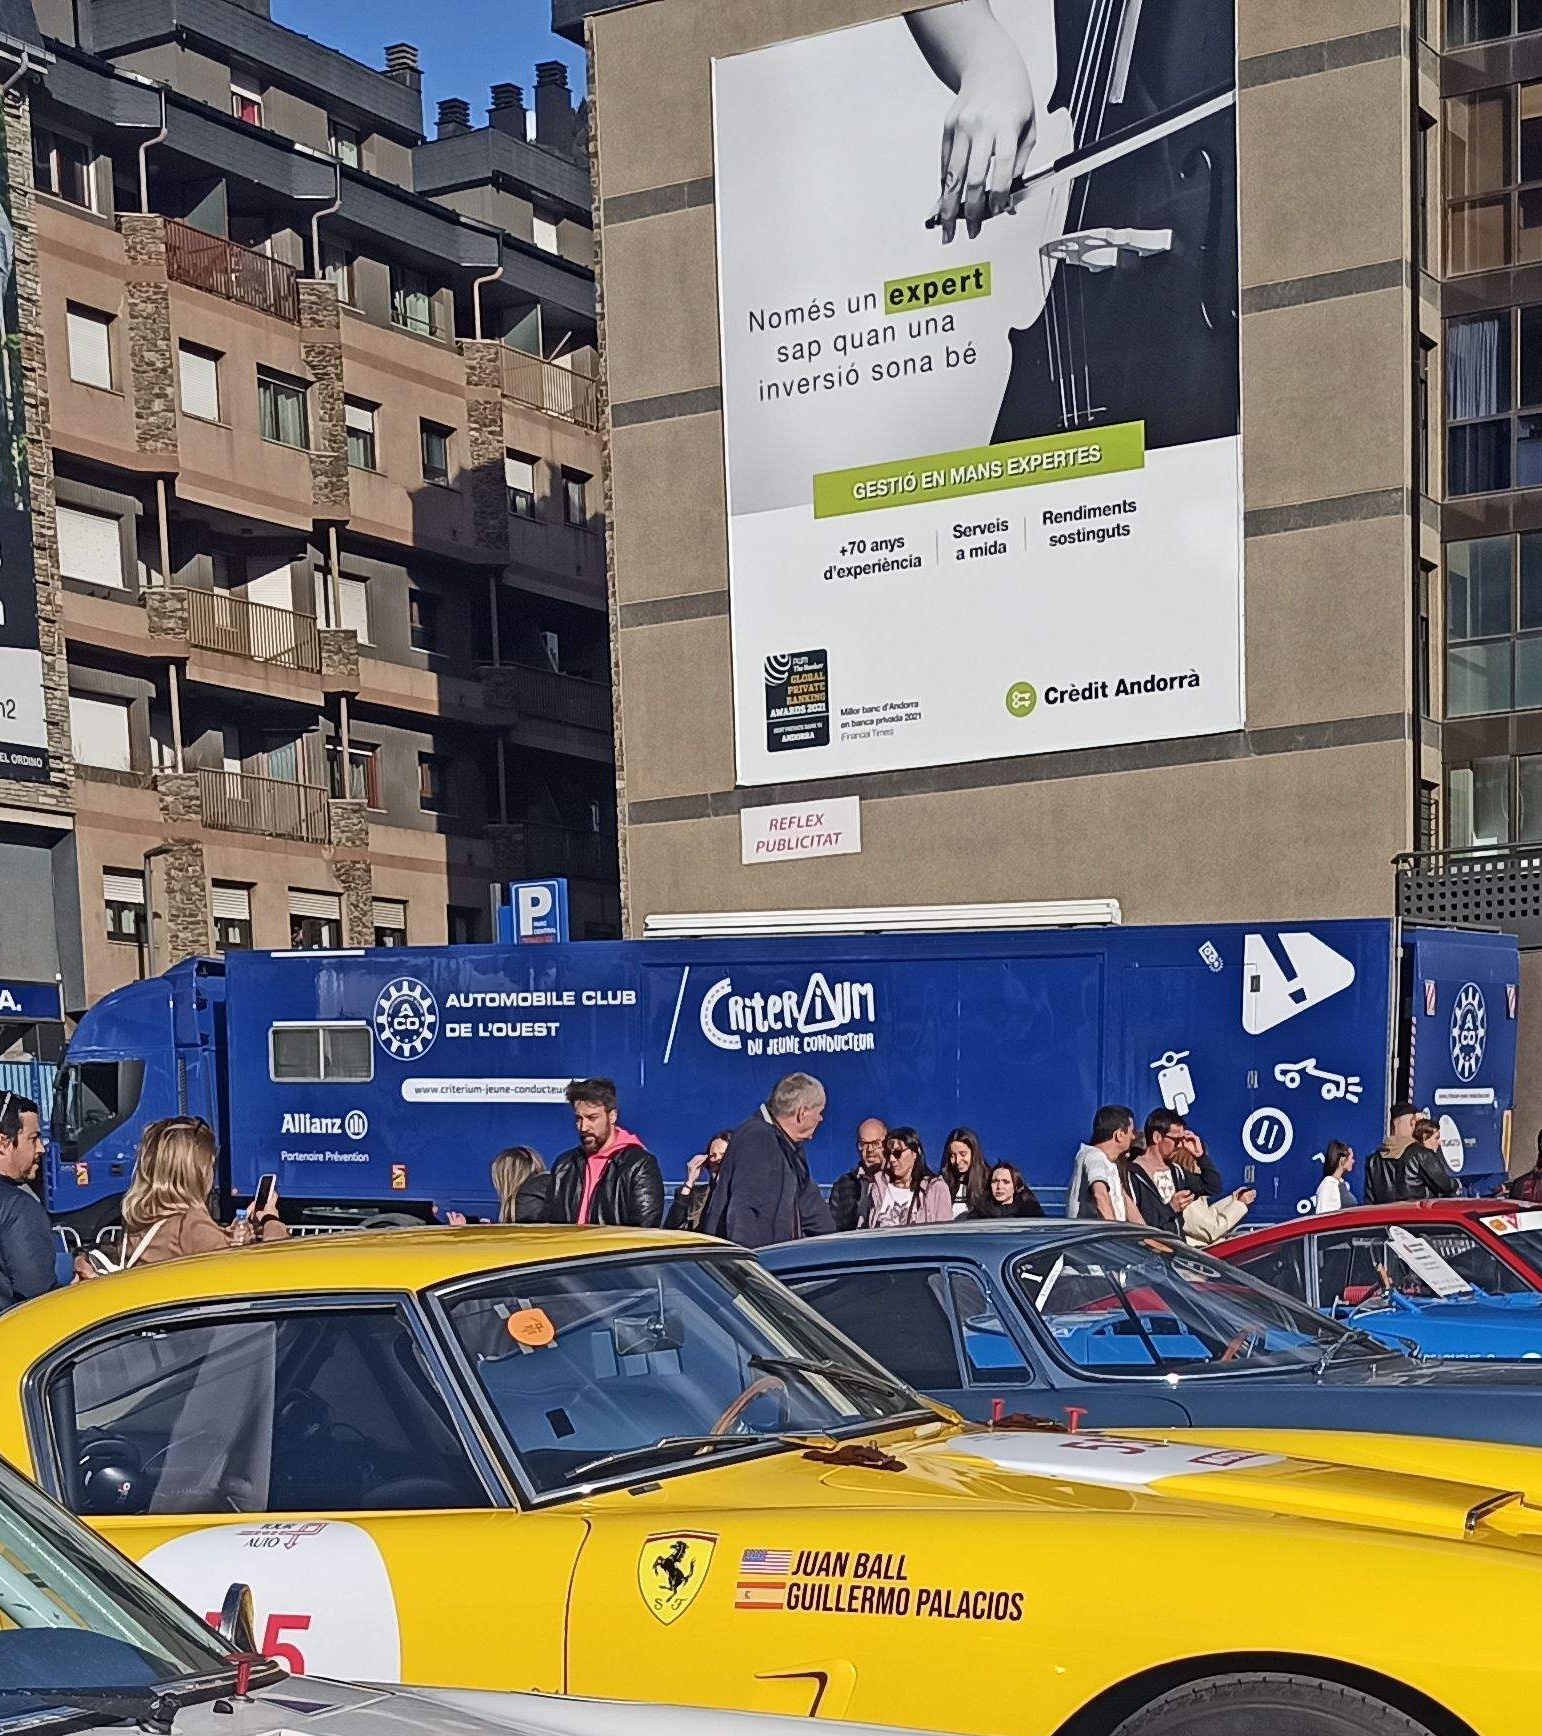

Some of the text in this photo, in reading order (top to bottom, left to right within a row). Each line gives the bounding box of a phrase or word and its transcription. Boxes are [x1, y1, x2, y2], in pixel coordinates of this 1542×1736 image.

[748, 267, 984, 333] Només un expert
[776, 313, 956, 364] sap quan una
[759, 340, 978, 402] inversió sona bé
[852, 443, 1103, 501] GESTIÓ EN MANS EXPERTES
[1042, 499, 1138, 527] Rendiments
[952, 518, 1010, 541] Serveis
[1048, 521, 1132, 549] sostinguts
[839, 535, 906, 559] +70 anys
[955, 541, 1008, 562] a mida
[823, 553, 923, 583] d'experiència
[1043, 667, 1203, 707] Crèdit Andorrà
[10, 752, 45, 770] ORDINO
[768, 812, 826, 832] REFLEX
[755, 831, 843, 855] PUBLICITAT
[518, 885, 553, 936] P
[445, 990, 638, 1008] AUTOMOBILE CLUB
[445, 1021, 561, 1038] DE L'OUEST
[746, 1032, 876, 1056] DU JEUNE CONDUCTEUR
[280, 1112, 343, 1135] Allianz
[281, 1149, 370, 1163] Partenaire Prévention
[790, 1549, 909, 1581] JUAN BALL
[786, 1581, 1025, 1622] GUILLERMO PALACIOS
